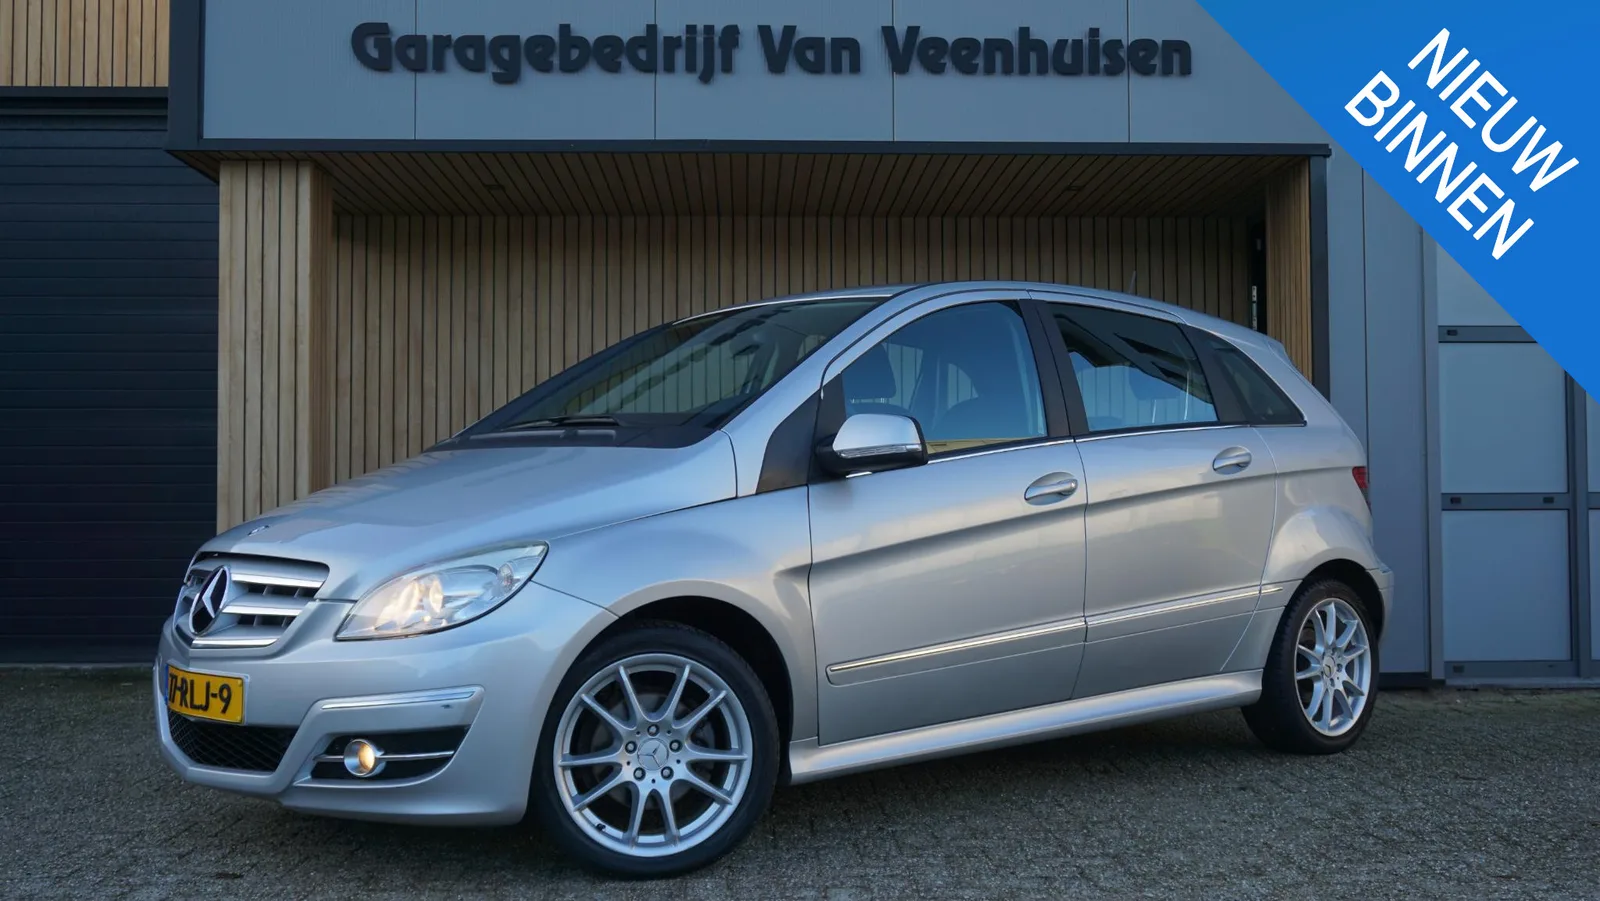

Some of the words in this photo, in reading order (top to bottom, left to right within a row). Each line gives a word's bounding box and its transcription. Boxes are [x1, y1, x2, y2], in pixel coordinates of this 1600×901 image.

[351, 22, 741, 84] Garagebedrijf
[757, 25, 861, 75] Van
[881, 26, 1192, 76] Veenhuisen
